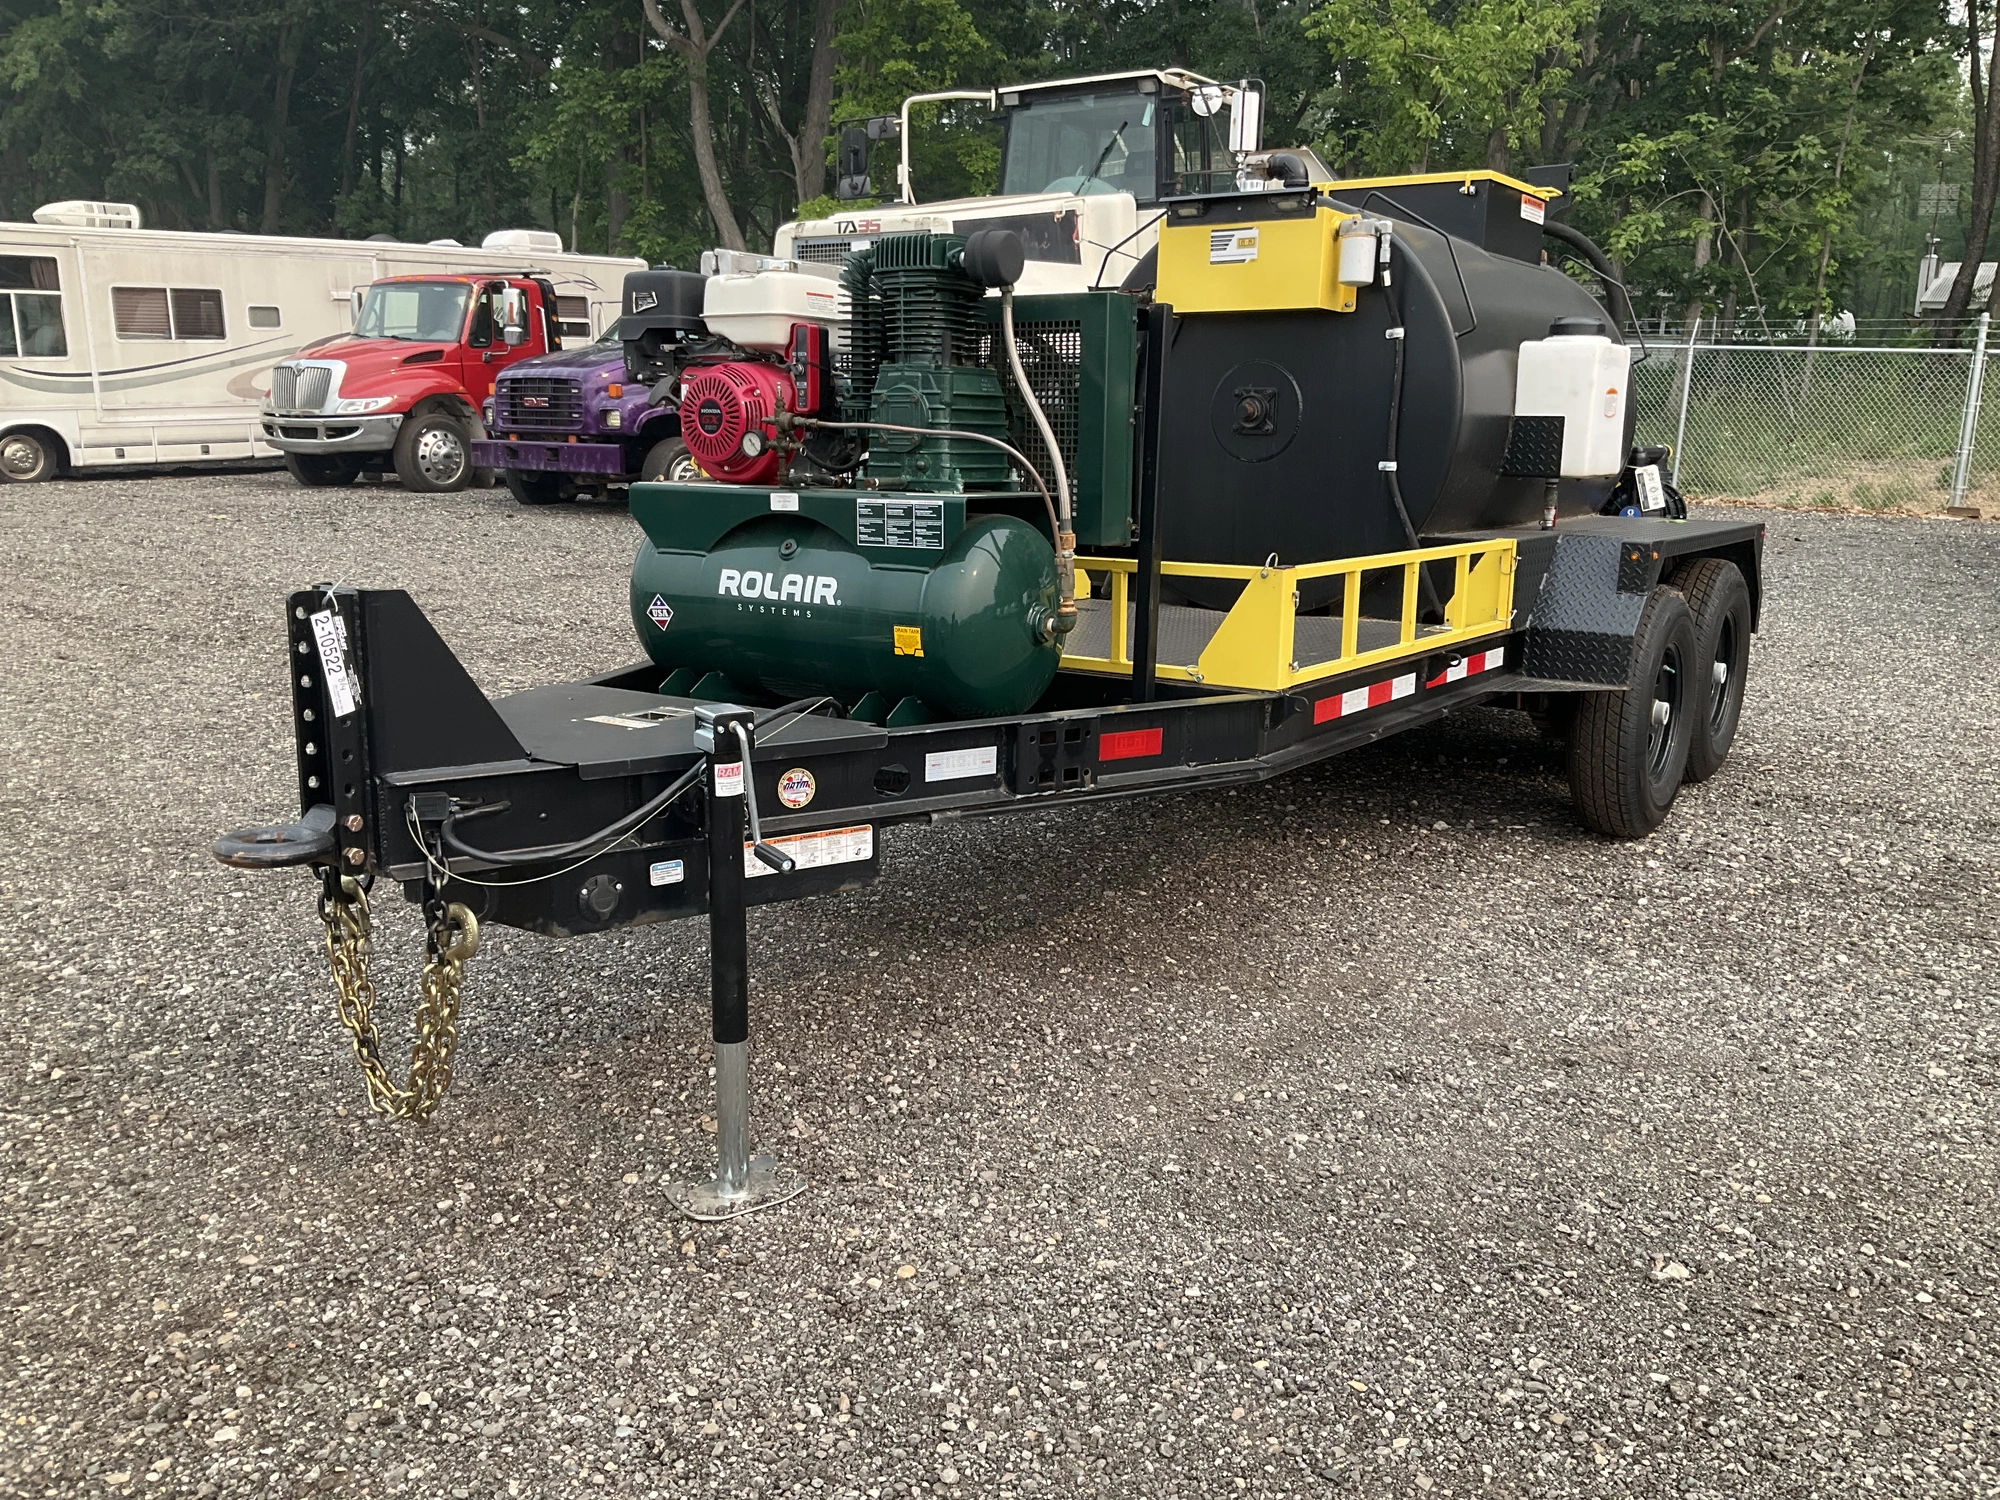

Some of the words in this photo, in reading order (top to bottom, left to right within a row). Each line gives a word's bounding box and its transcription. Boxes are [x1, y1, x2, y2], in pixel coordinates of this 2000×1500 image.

[833, 219, 882, 235] TA35
[523, 397, 549, 408] GMC
[702, 415, 719, 424] GX
[718, 568, 838, 606] ROLAIR
[651, 609, 669, 617] USA
[737, 603, 812, 618] SYSTEMS
[314, 615, 342, 676] 2-10522
[717, 765, 742, 778] RAM
